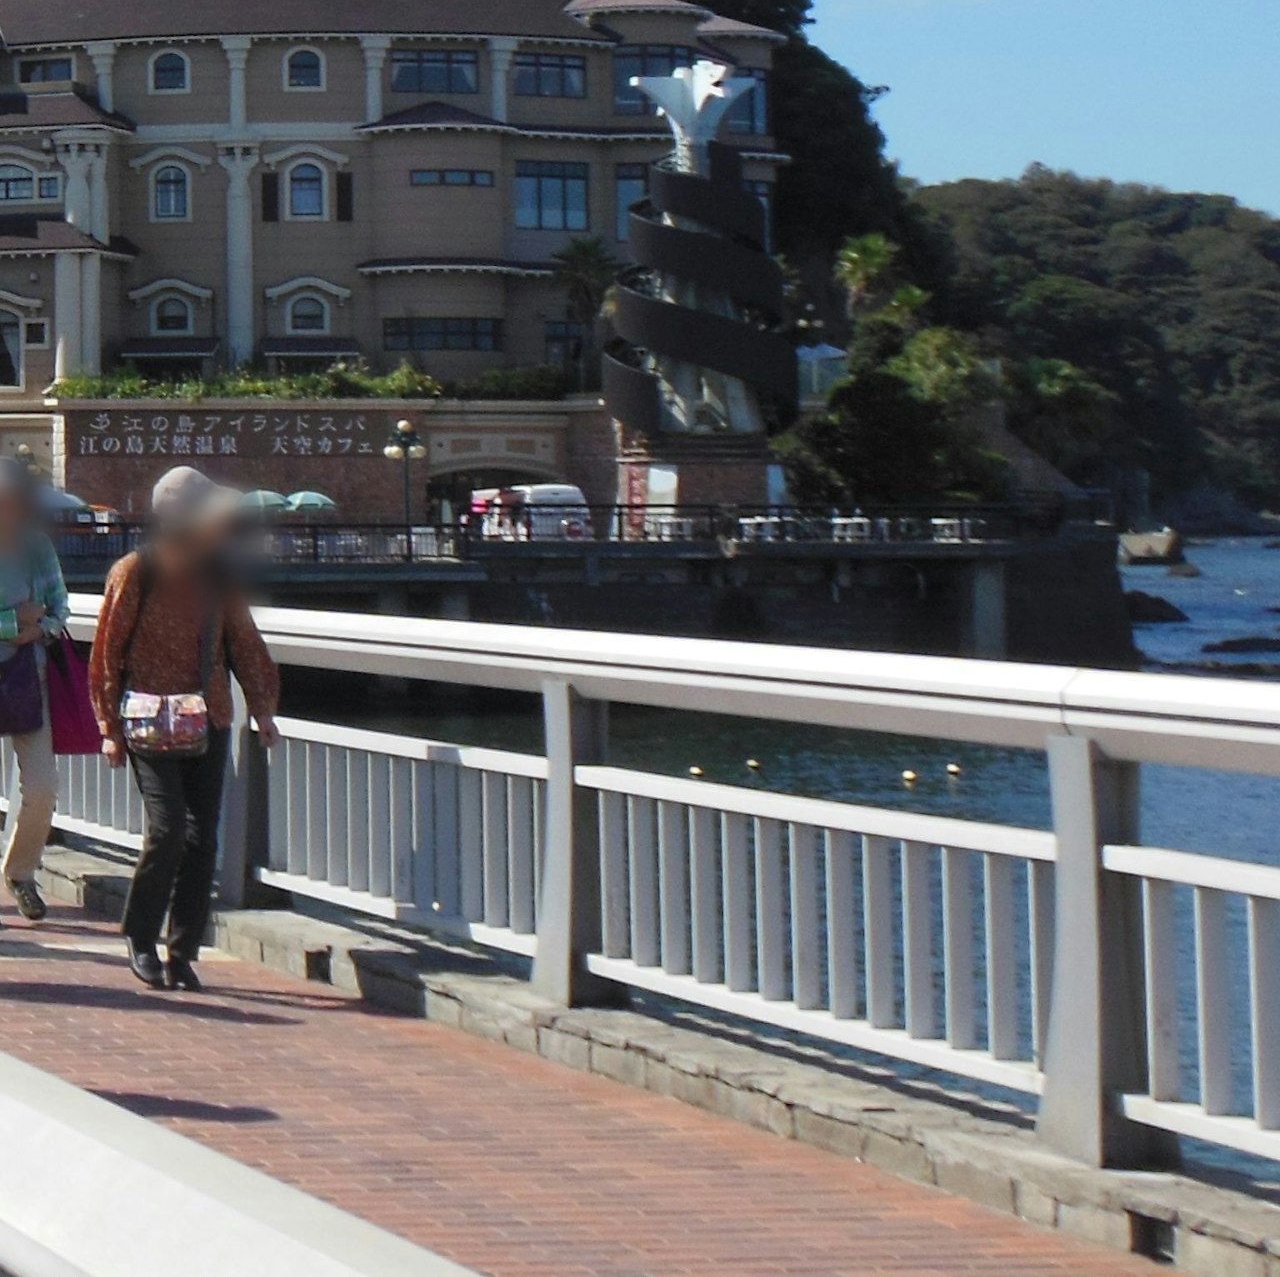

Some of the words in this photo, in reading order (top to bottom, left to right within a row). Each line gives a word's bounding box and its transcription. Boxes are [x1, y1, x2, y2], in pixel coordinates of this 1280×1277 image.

[122, 415, 365, 432] 江の島アイランドスパ
[80, 436, 238, 454] 江の島天然温泉
[271, 436, 373, 454] 天空カフェ
